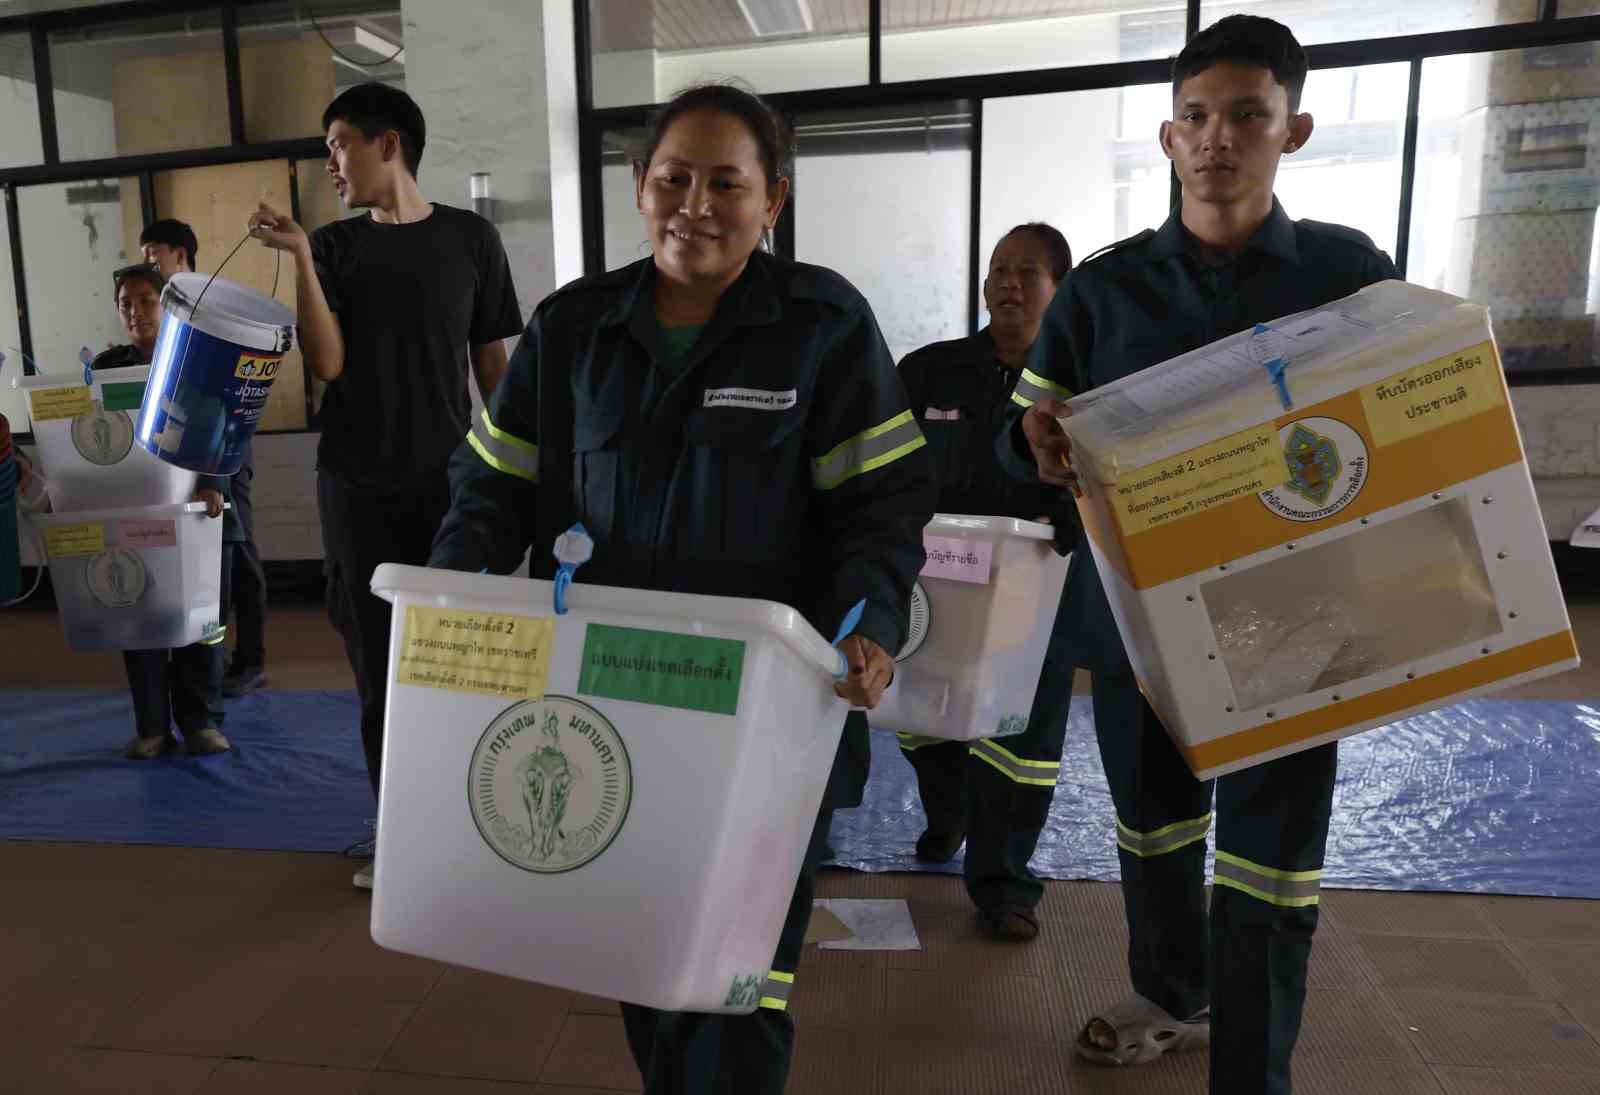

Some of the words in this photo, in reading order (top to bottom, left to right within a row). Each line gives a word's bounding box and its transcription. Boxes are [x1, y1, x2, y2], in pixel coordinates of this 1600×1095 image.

[1376, 355, 1482, 400] หีบบัตรออกเสียง
[1405, 386, 1468, 419] ประชามติ
[1187, 459, 1197, 472] 2
[505, 621, 515, 634] 2
[592, 655, 732, 681] แบบแบ่งเขตเลือกตั้ง
[489, 712, 536, 755] กรุงเทพ
[569, 714, 616, 765] มหานคร
